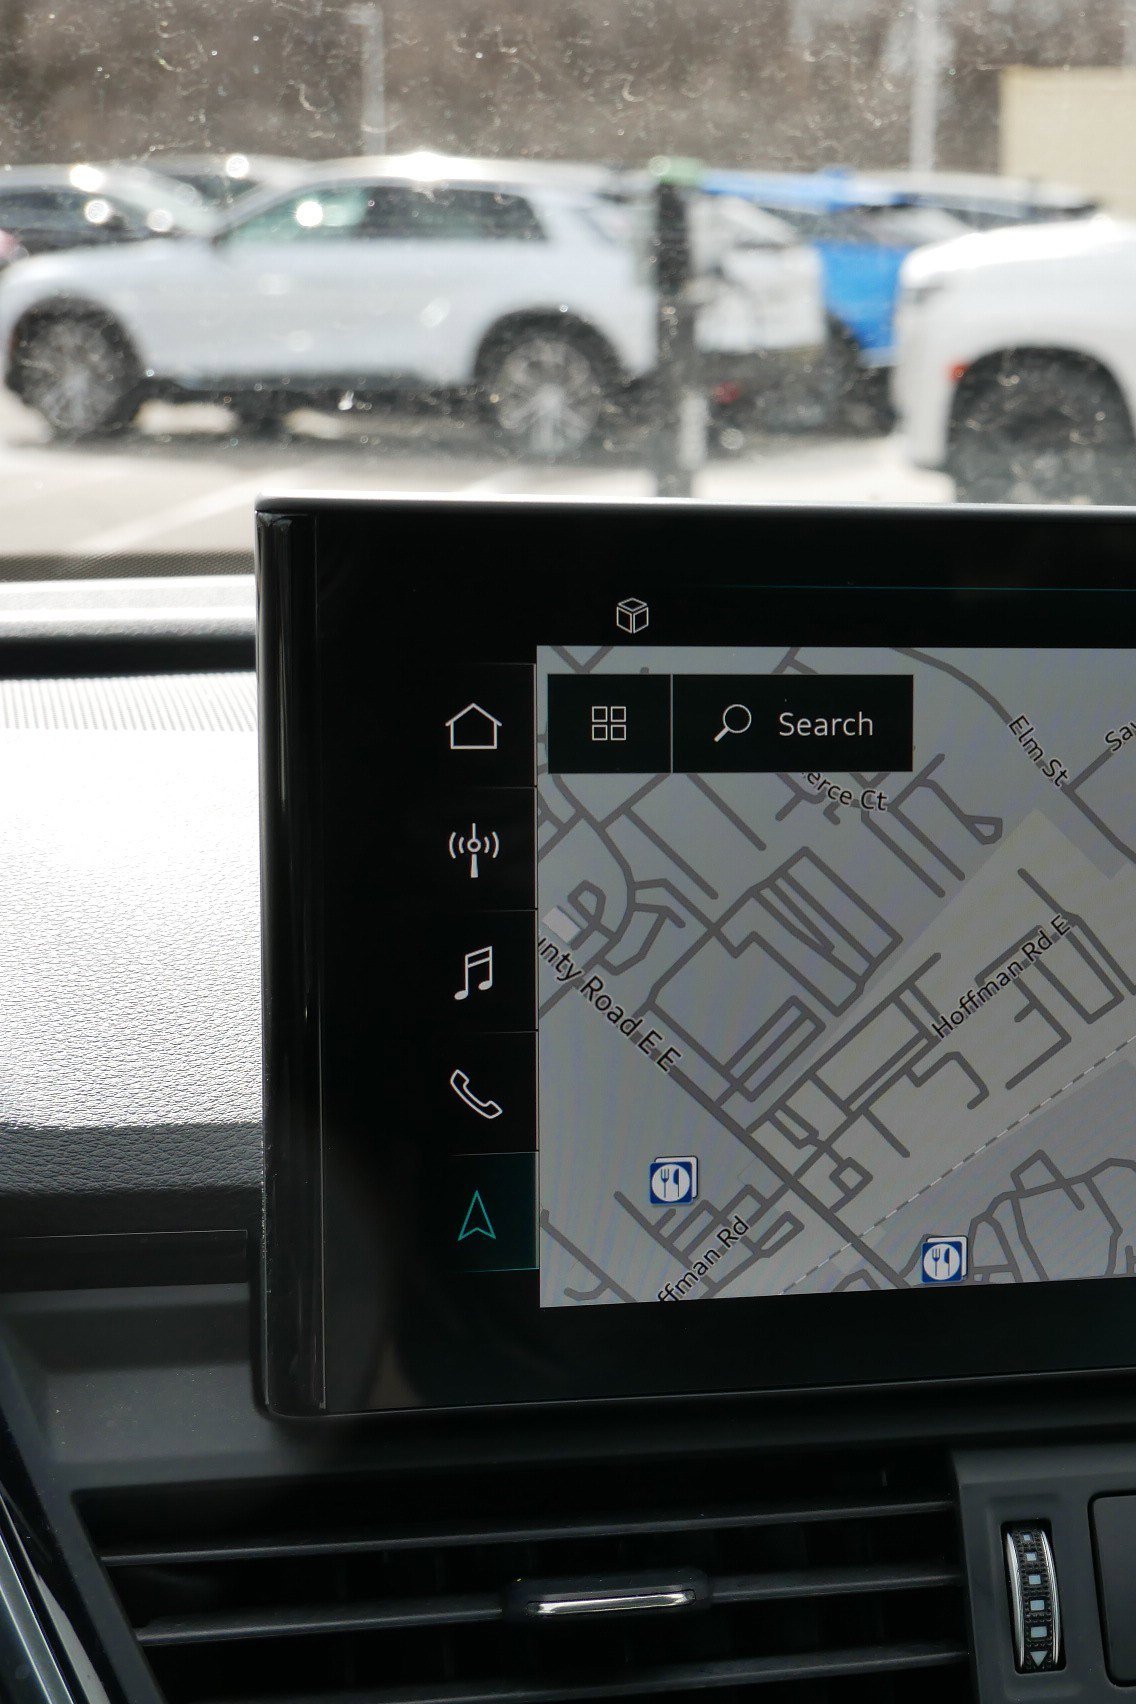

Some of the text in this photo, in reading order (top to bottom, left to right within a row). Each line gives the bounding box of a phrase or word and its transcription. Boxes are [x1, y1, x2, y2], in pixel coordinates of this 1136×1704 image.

[778, 710, 874, 737] Search
[1008, 714, 1069, 788] Elm St
[806, 772, 888, 811] erce Ct
[931, 914, 1072, 1039] Hoffman Rd E
[579, 974, 644, 1038] Road
[637, 1029, 664, 1056] E
[656, 1046, 683, 1073] E
[716, 1214, 750, 1249] Rd
